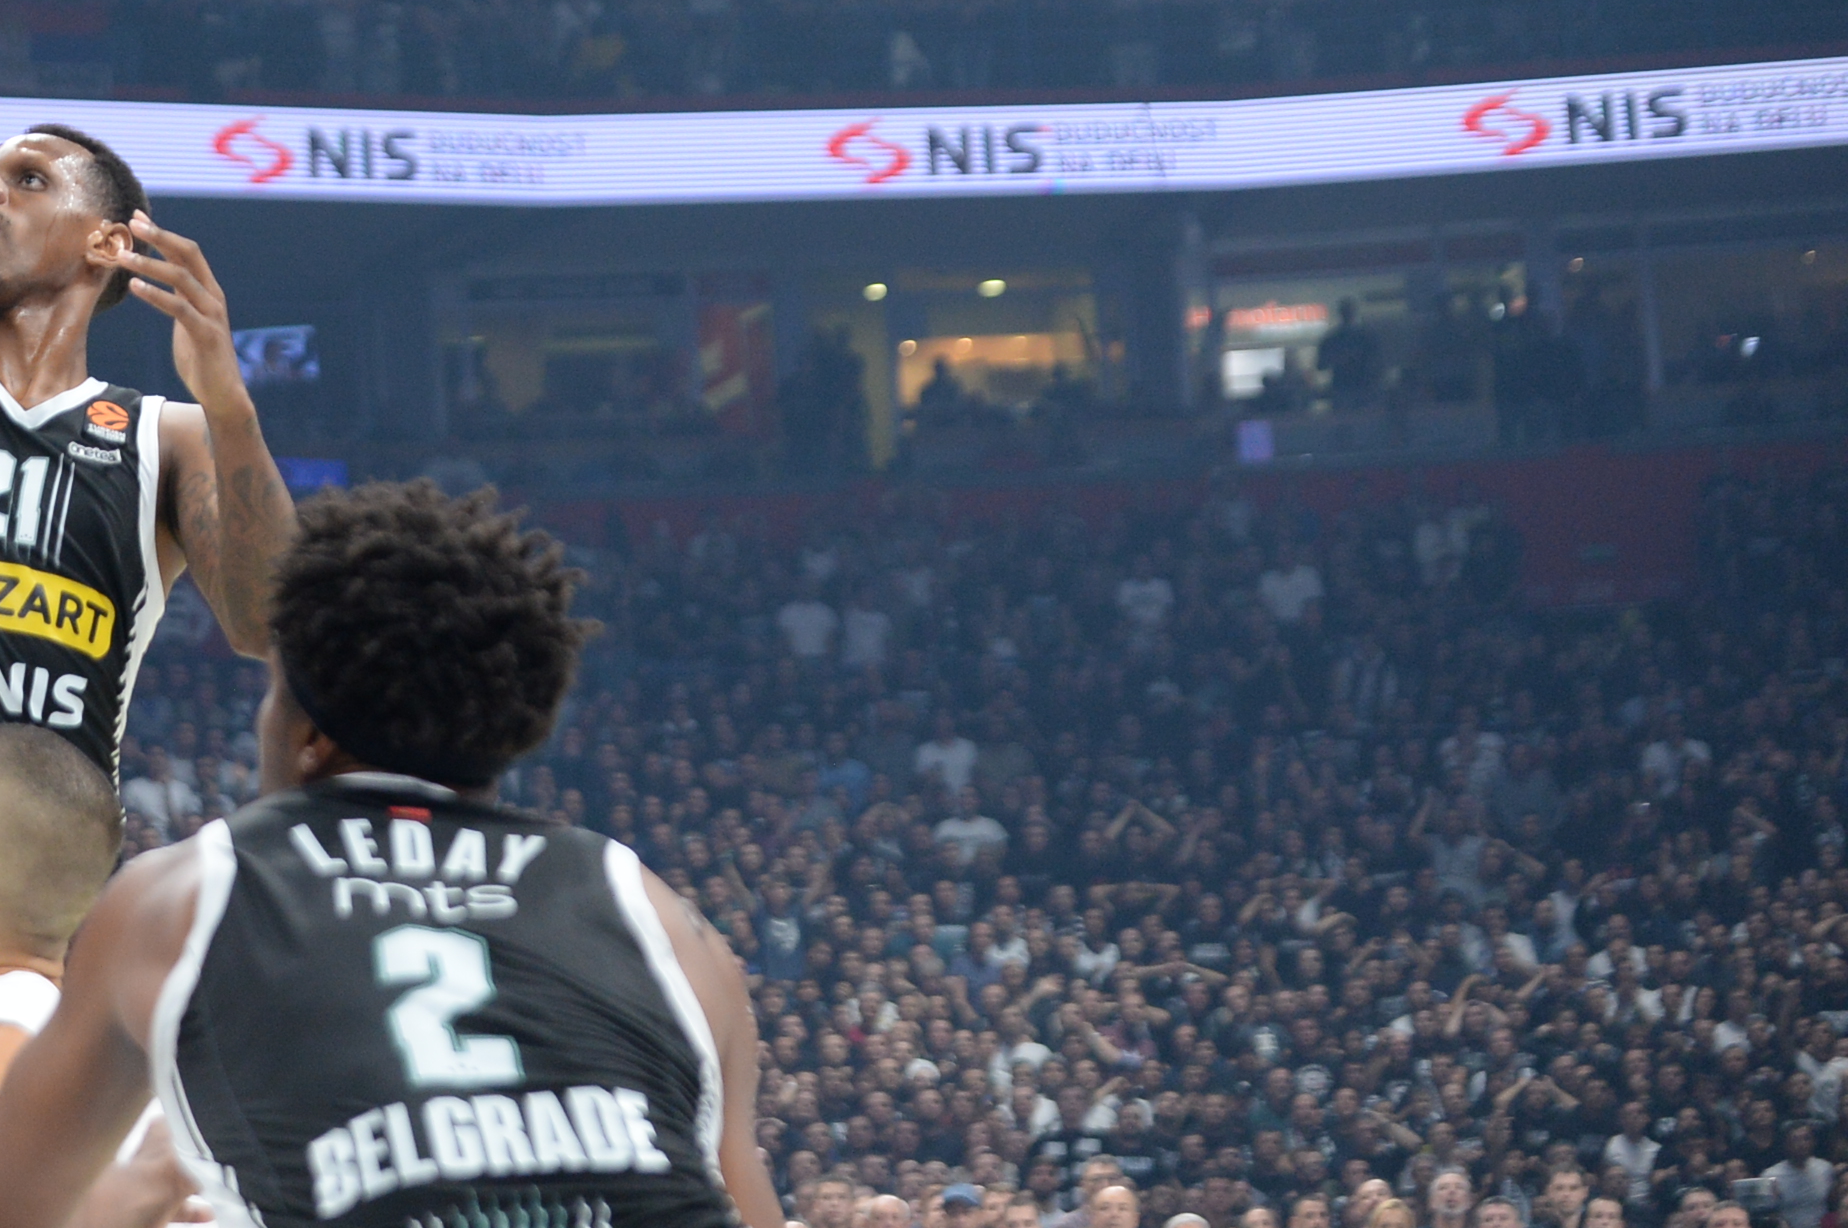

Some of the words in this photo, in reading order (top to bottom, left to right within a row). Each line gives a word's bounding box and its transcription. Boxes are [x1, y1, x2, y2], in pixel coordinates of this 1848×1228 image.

[1566, 85, 1686, 144] NIS
[308, 125, 418, 180] NIS
[928, 123, 1043, 174] NIS
[289, 818, 547, 884] LEDAY
[331, 877, 519, 924] mts
[372, 923, 526, 1091] 2
[306, 1084, 671, 1220] BELGRADE
